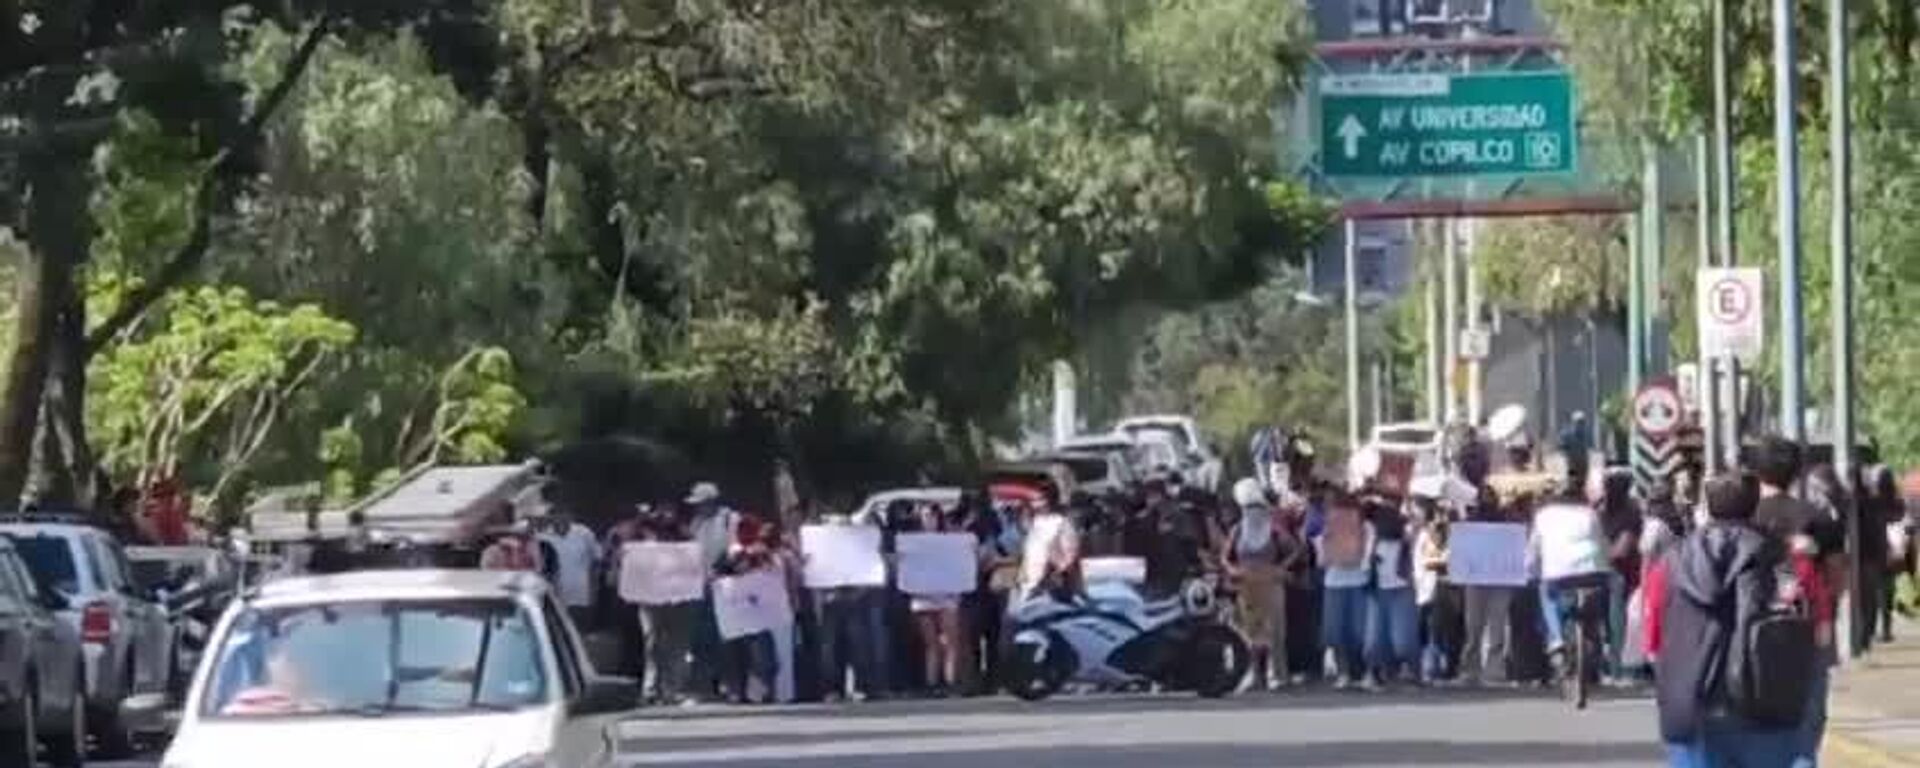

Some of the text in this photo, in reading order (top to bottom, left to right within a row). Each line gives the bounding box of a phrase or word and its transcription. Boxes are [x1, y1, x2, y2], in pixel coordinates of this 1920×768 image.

[1379, 107, 1405, 130] AV
[1379, 140, 1409, 165] AV
[1419, 139, 1514, 164] COPILCO
